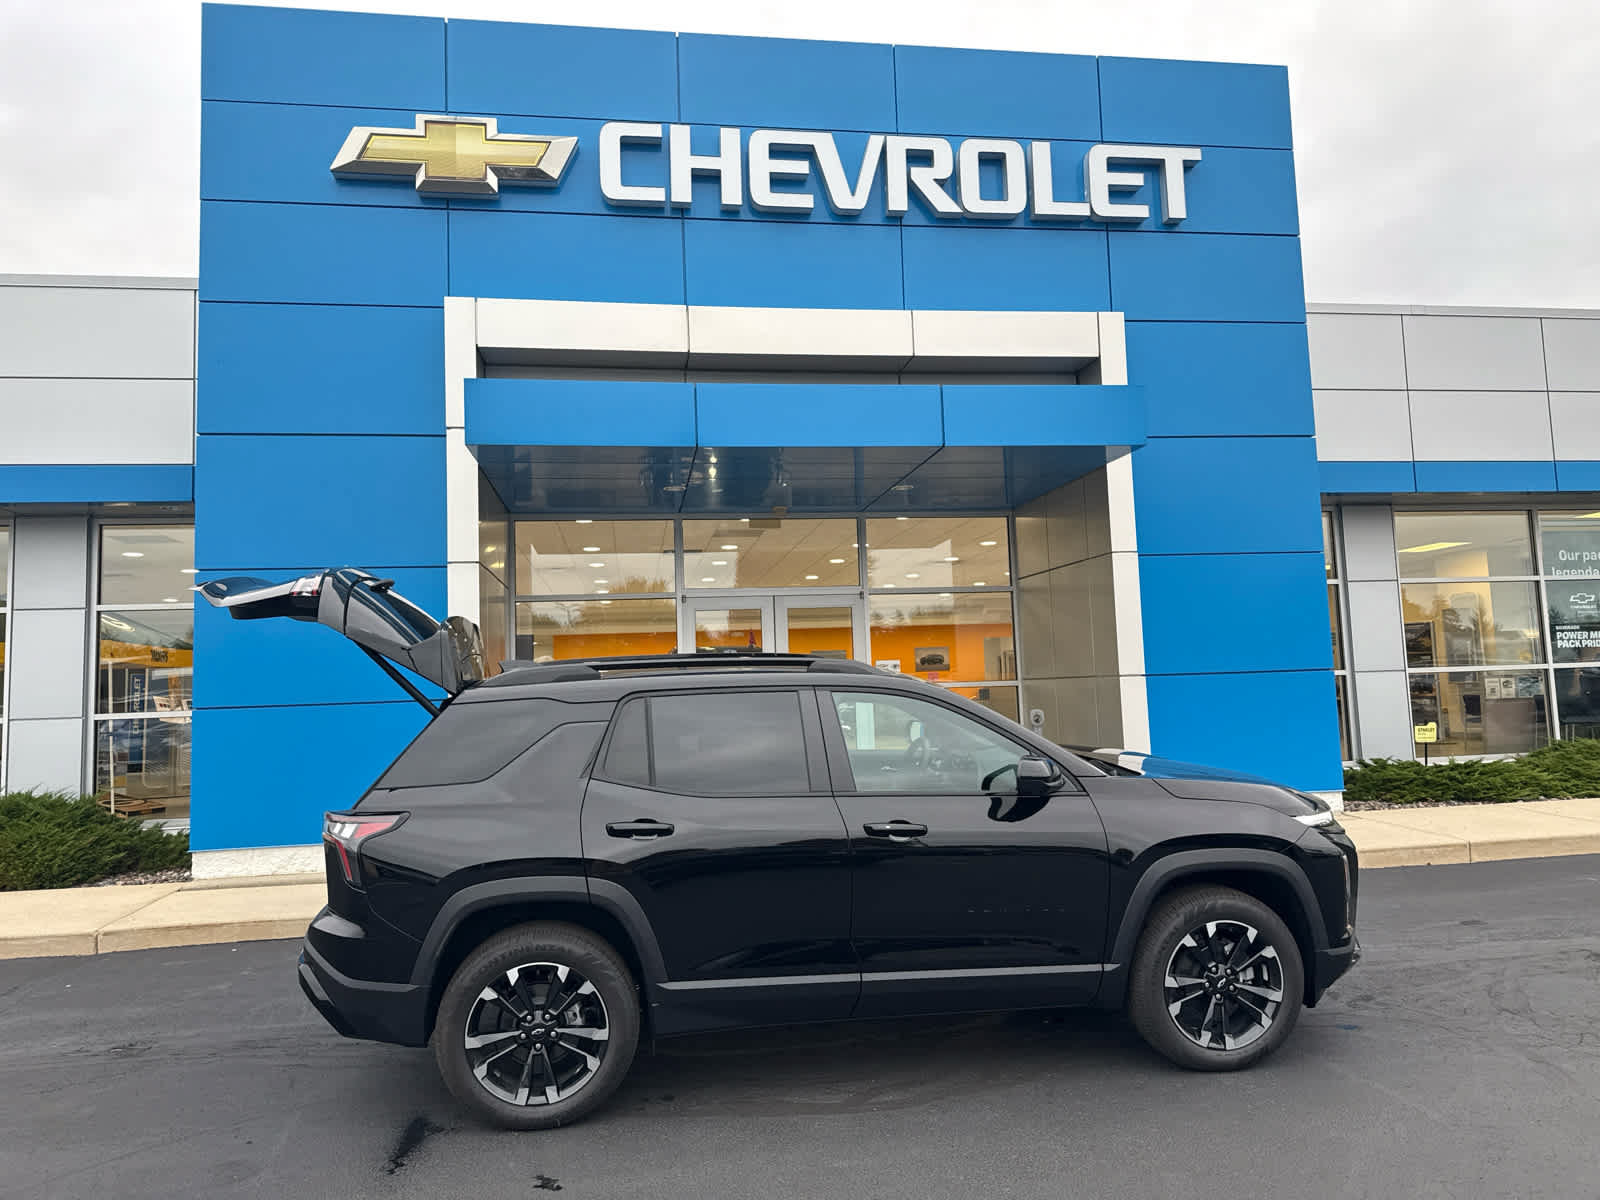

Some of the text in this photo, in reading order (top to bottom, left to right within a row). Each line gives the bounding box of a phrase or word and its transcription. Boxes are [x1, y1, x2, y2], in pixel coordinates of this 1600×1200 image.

[600, 121, 1202, 222] CHEVROLET
[1558, 550, 1580, 561] Our
[1556, 631, 1589, 640] POWER
[1557, 639, 1581, 649] PACK
